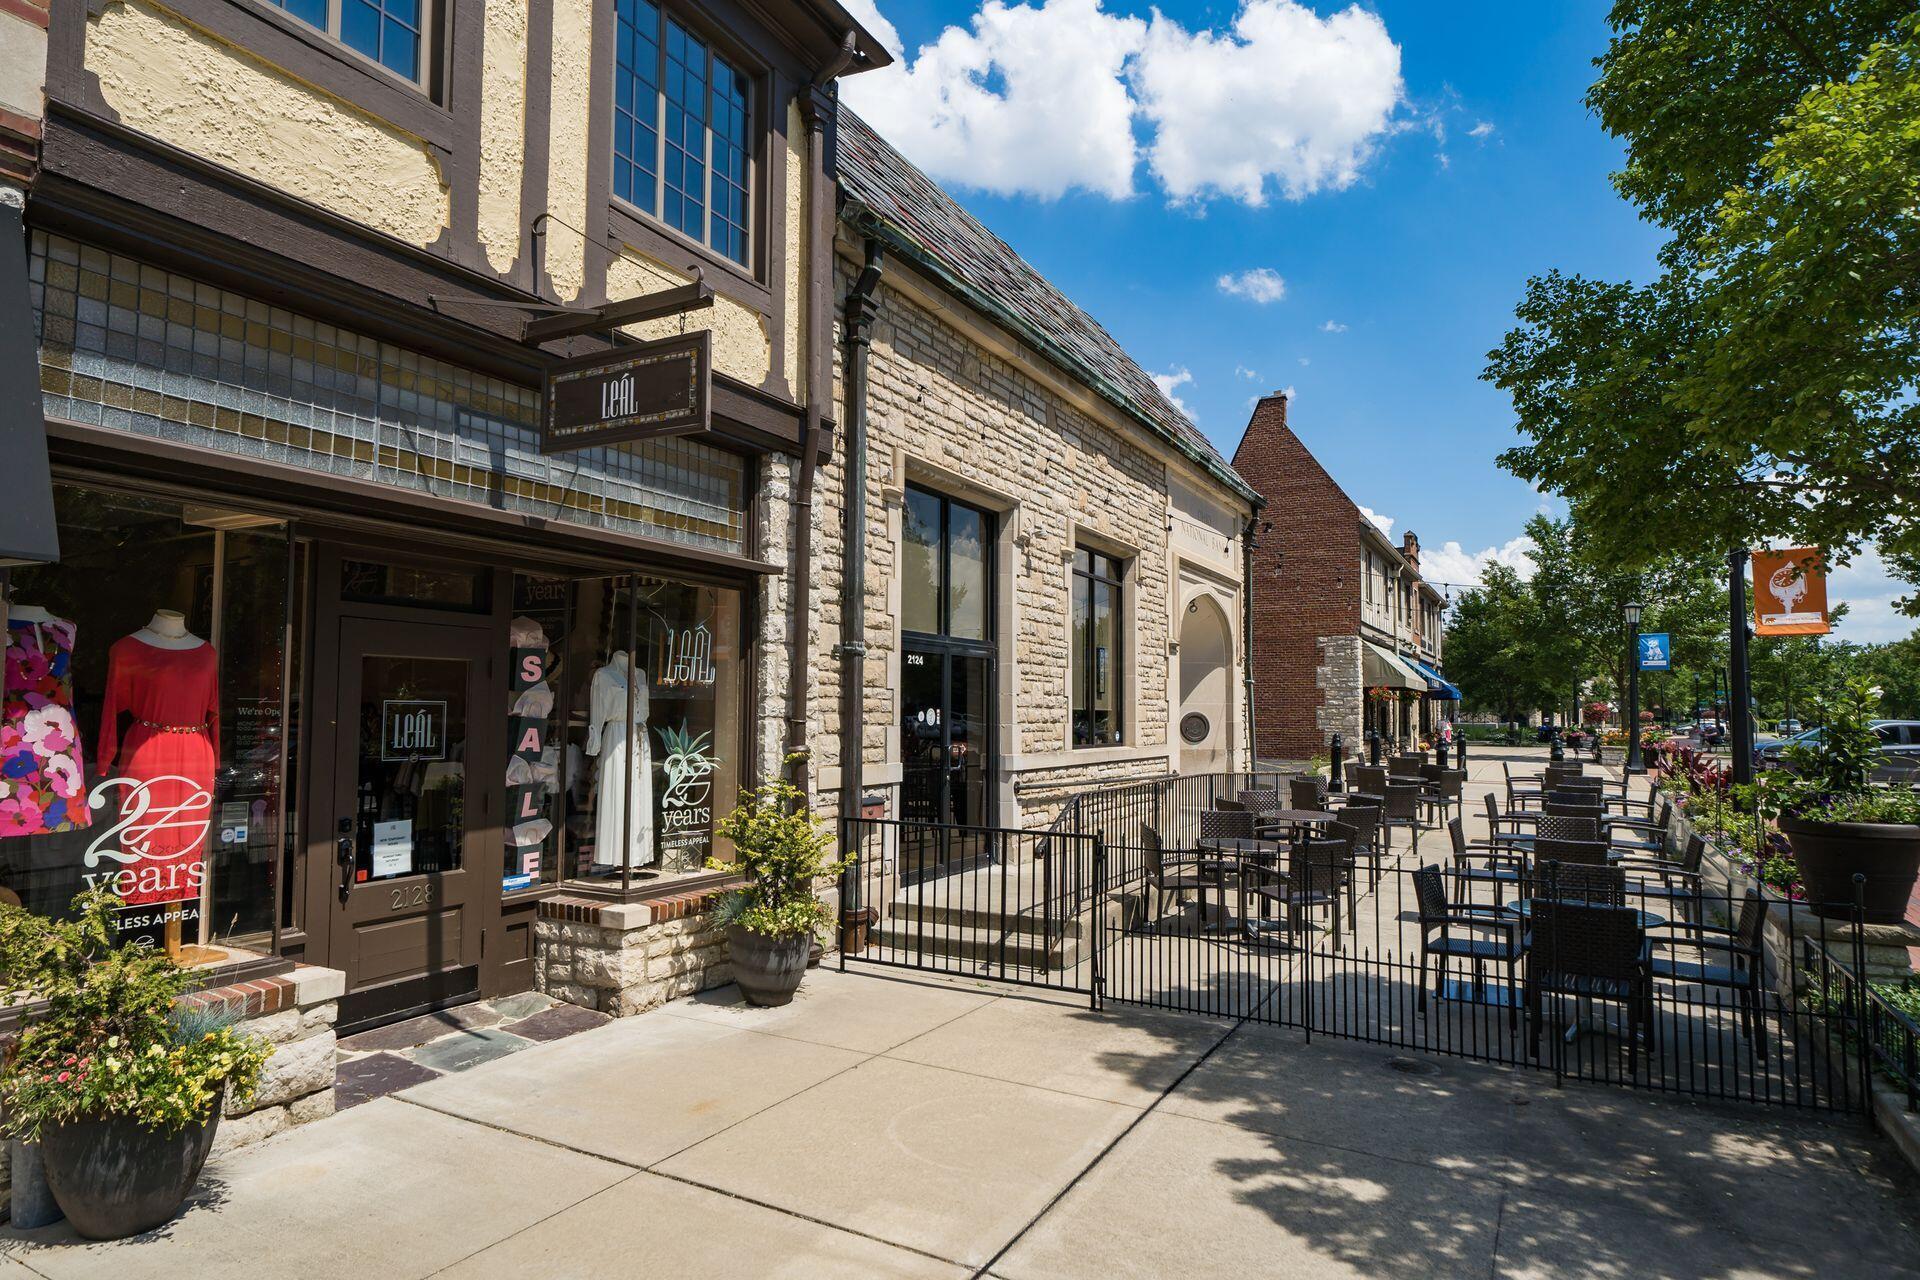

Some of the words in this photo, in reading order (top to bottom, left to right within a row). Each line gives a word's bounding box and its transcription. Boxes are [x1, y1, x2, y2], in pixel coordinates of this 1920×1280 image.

[907, 654, 924, 665] 2124
[238, 707, 263, 716] We're
[662, 806, 711, 833] years
[660, 838, 688, 850] TIMELESS
[688, 836, 710, 846] APPEAL
[391, 883, 434, 911] 2128
